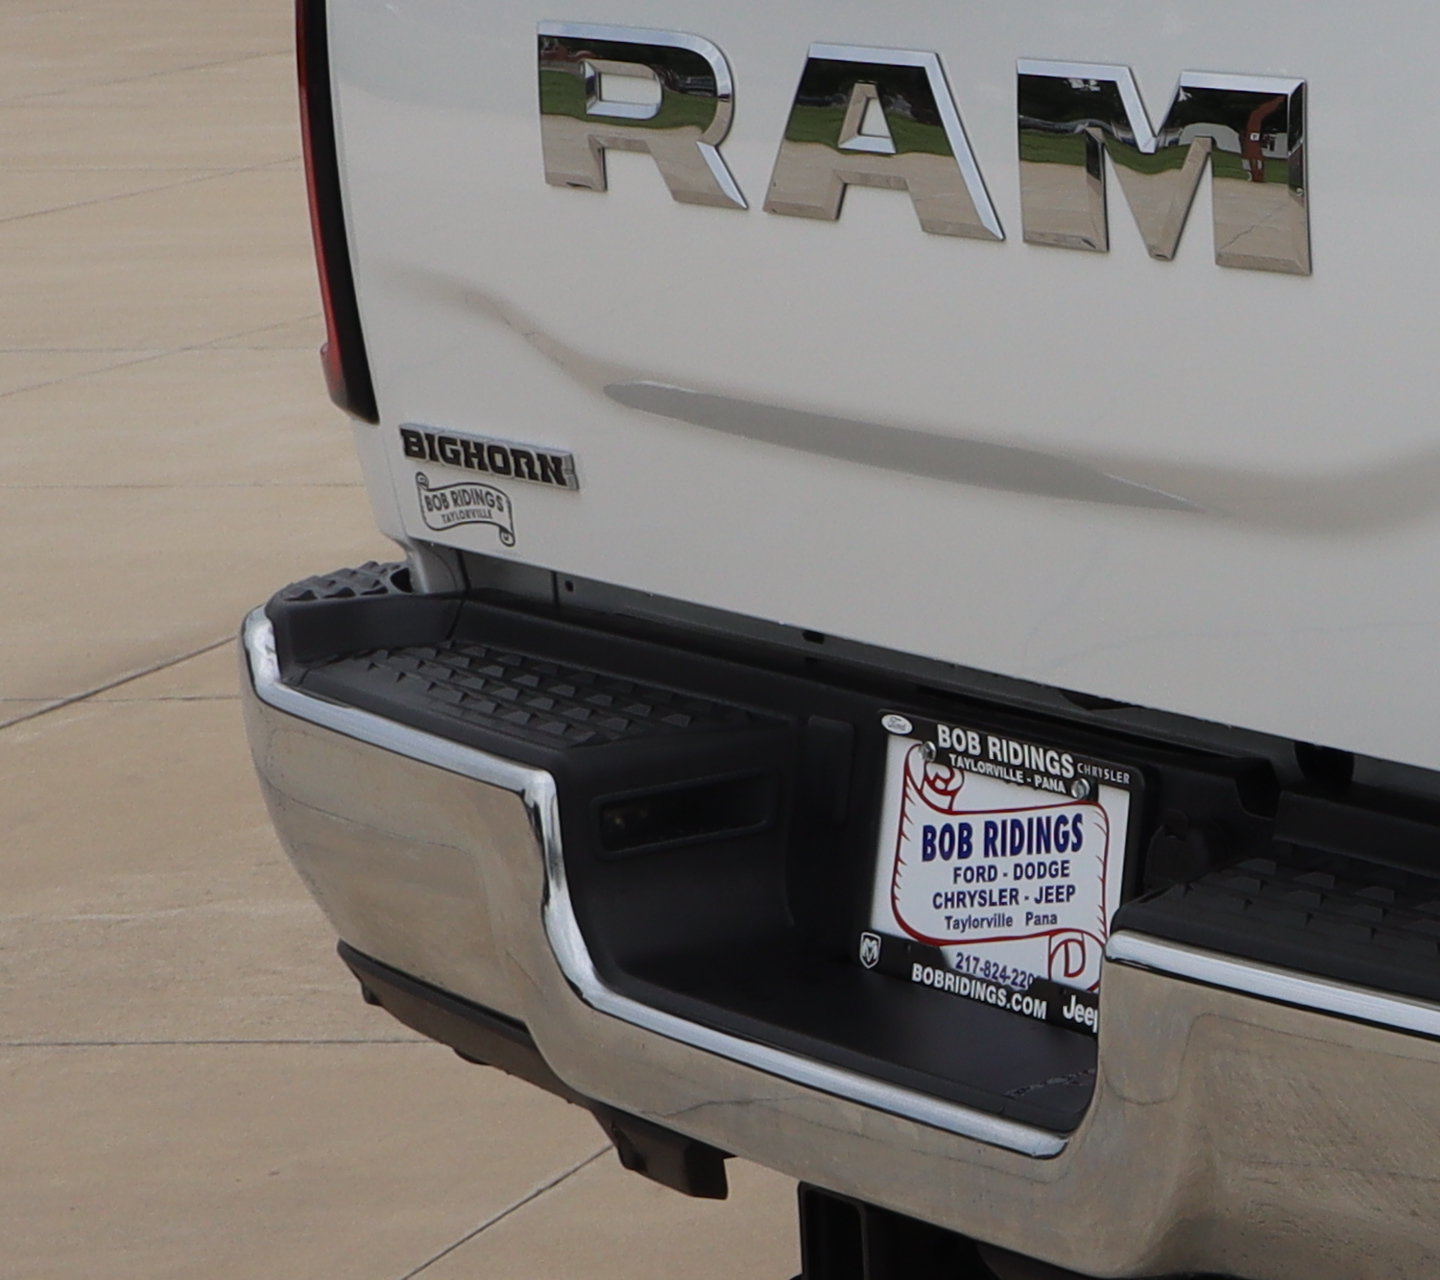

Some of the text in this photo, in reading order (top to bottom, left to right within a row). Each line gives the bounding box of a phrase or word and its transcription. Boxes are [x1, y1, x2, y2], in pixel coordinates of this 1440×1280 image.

[538, 21, 1312, 275] RAM
[400, 425, 574, 489] BIGHORN
[424, 487, 504, 513] BOB RIDINGS
[441, 509, 493, 524] TAYLORVILLE
[936, 723, 1075, 779] BOB RIDINGS
[948, 753, 1024, 784] TAYLORVILLE
[1034, 774, 1067, 794] PANA
[1076, 762, 1130, 785] CHRYSLER
[921, 813, 1084, 862] BOB RIDINGS
[953, 864, 998, 884] FORD
[1013, 860, 1070, 881] DODGE
[932, 887, 1020, 910] CHRYSLER
[1034, 884, 1076, 904] JEEP
[944, 911, 1058, 934] Taylorville Pana
[911, 962, 1047, 1021] BOBRIDINGS.COM
